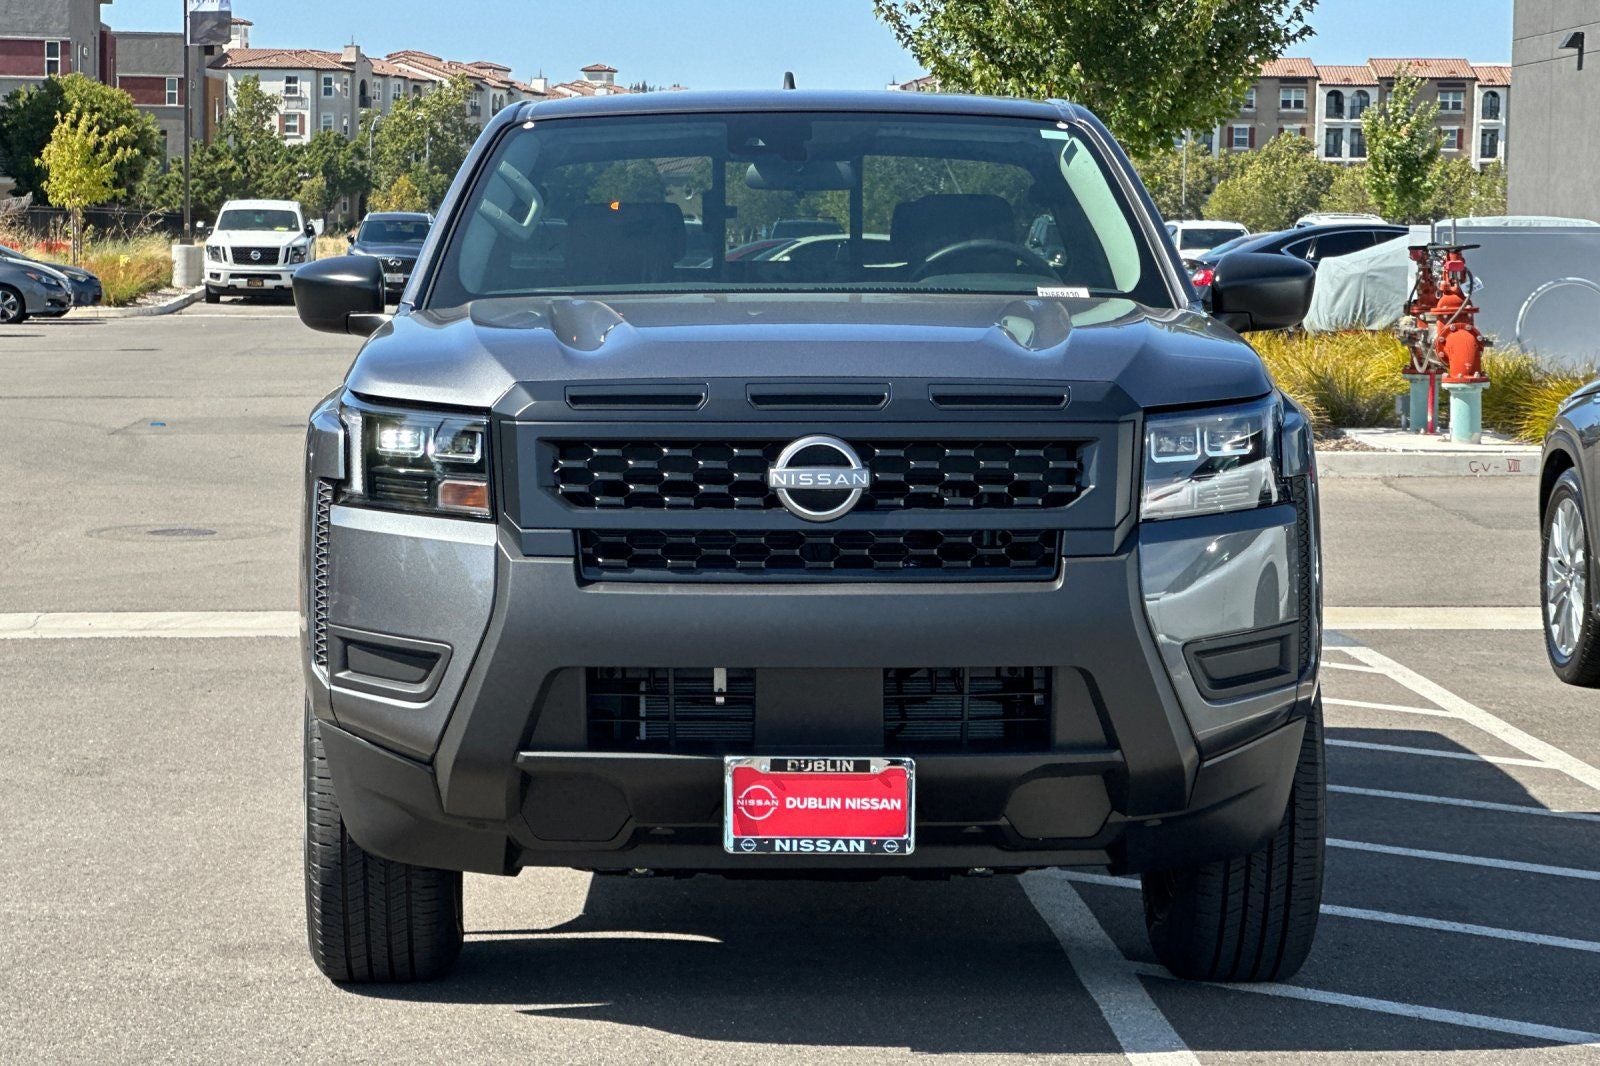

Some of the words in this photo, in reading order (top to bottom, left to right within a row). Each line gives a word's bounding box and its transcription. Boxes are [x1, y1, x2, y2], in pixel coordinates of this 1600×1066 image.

[772, 473, 867, 486] NISSAN
[787, 759, 854, 772] DUBLIN
[736, 799, 779, 807] NISSAN
[785, 797, 841, 810] DUBLIN
[845, 797, 901, 811] NISSAN
[774, 839, 865, 853] NISSAN
